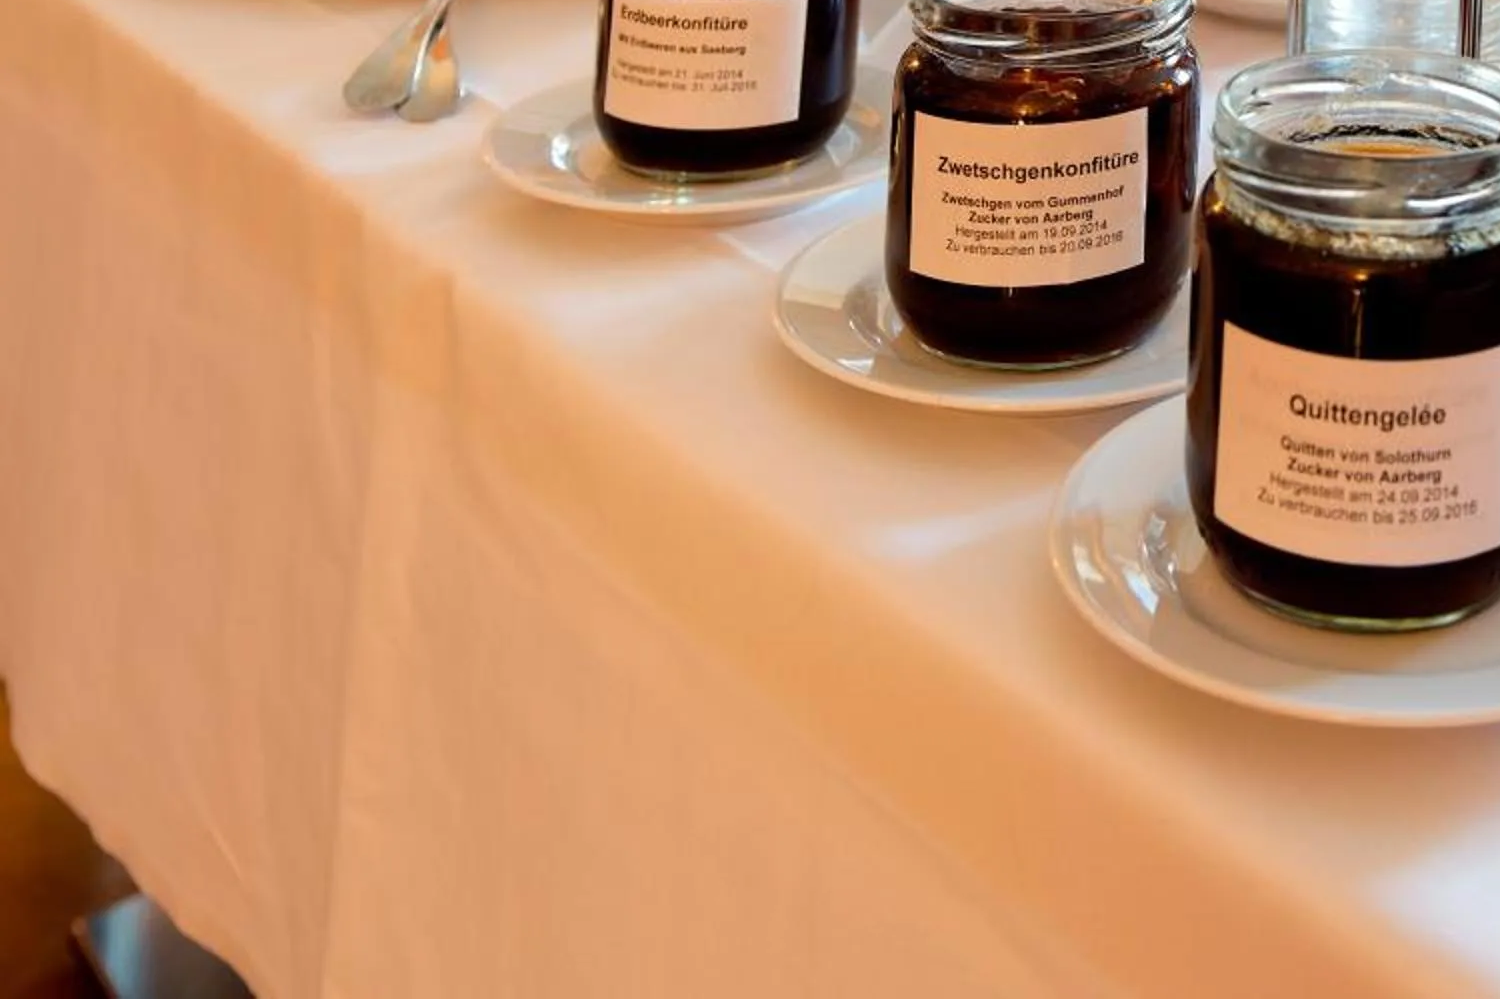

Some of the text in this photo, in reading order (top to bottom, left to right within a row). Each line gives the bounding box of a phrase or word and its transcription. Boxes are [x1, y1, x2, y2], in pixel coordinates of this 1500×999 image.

[620, 4, 748, 32] Erdbeerkonfitüre
[630, 35, 677, 52] Erdbeeren
[679, 45, 697, 54] aus
[937, 151, 1139, 183] Zwetschgenkonfitüre
[941, 185, 1124, 211] Zwetschgen vom Gummenhof
[968, 209, 1093, 224] Zucker von Aarberg
[946, 239, 960, 251] Zu
[963, 243, 1035, 255] verbrauchen
[1039, 244, 1057, 255] bis
[955, 226, 1015, 241] Hergestellt
[1019, 230, 1038, 239] am
[1289, 394, 1446, 432] Quittengelée
[1280, 435, 1452, 465] Quitten von Solothurn
[1287, 457, 1442, 484] Zucker von Aarberg
[1269, 472, 1344, 499] Hergestellt
[1349, 491, 1373, 502] am
[1257, 487, 1275, 504] Zu
[1279, 498, 1368, 523] verbrauchen
[1373, 511, 1394, 524] bis
